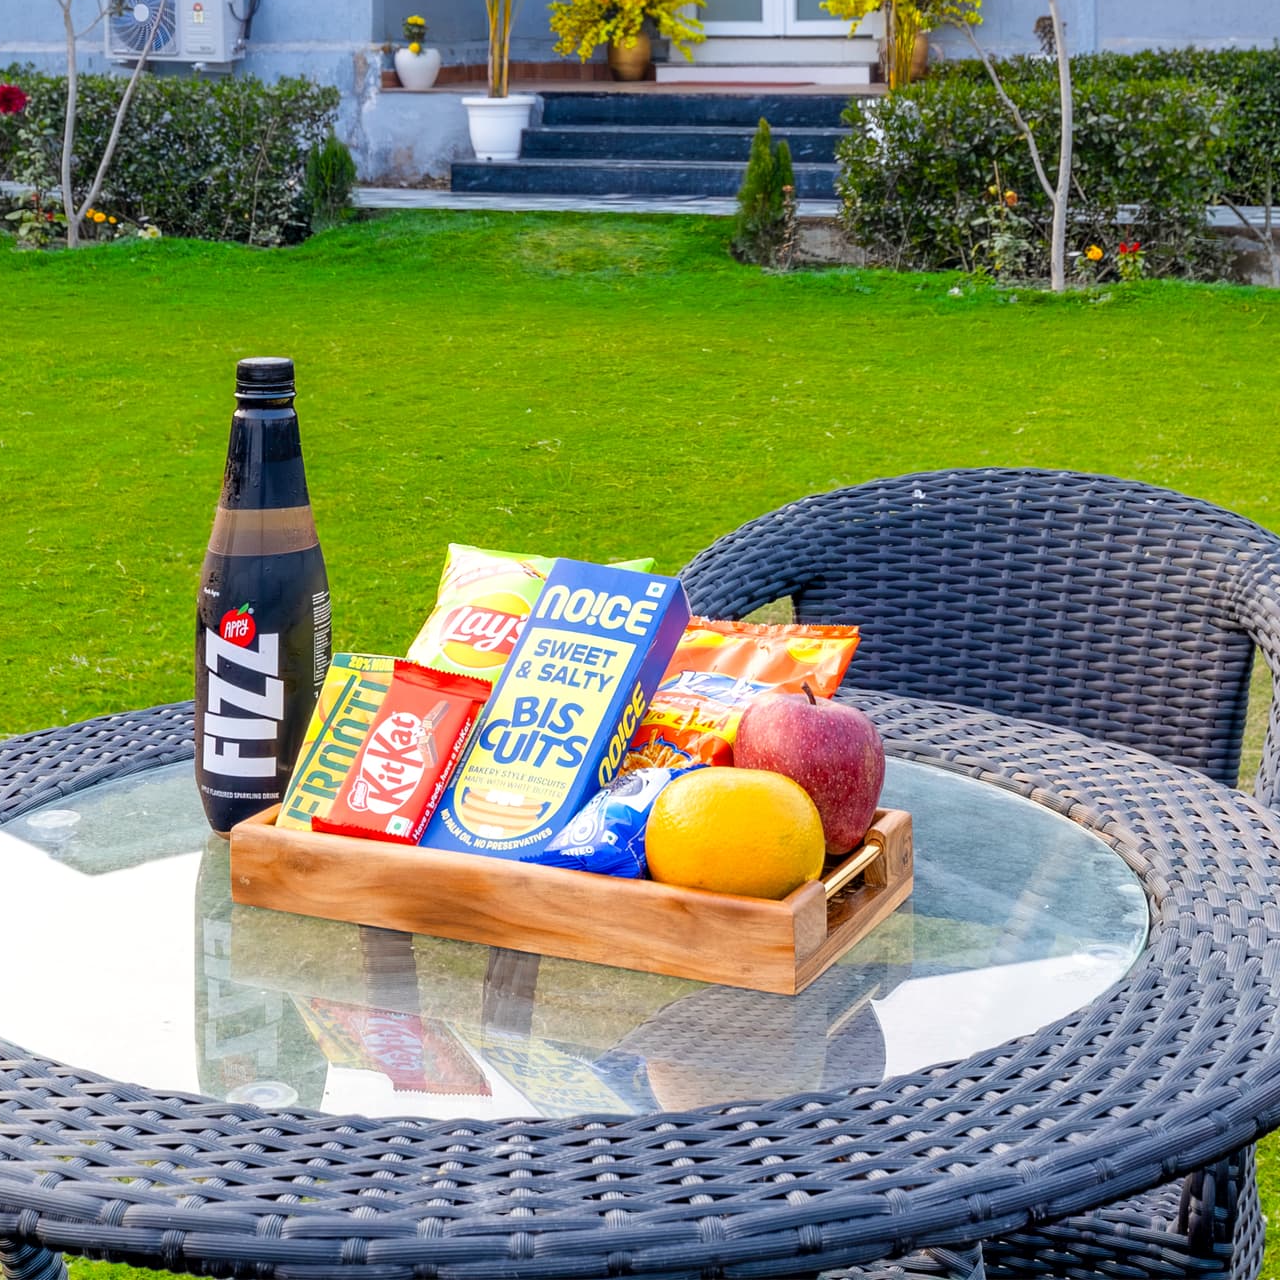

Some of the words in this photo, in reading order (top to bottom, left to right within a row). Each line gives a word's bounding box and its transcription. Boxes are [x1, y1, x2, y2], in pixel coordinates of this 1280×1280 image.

[534, 638, 618, 669] SWEET
[515, 660, 532, 679] &
[537, 663, 615, 693] SALTY
[203, 627, 285, 778] FIZZ
[511, 696, 585, 734] BIS
[286, 679, 391, 823] FROOTI
[362, 716, 424, 806] KitKat
[479, 719, 590, 769] CUITS
[467, 764, 500, 778] BAKERY
[500, 769, 527, 782] STYLE
[527, 774, 568, 790] BISCUITS
[486, 777, 506, 788] WITH
[412, 813, 428, 840] Have
[440, 808, 451, 822] NO
[446, 819, 461, 837] PALM
[474, 839, 486, 849] NO
[486, 827, 553, 851] PRESERVATIVES
